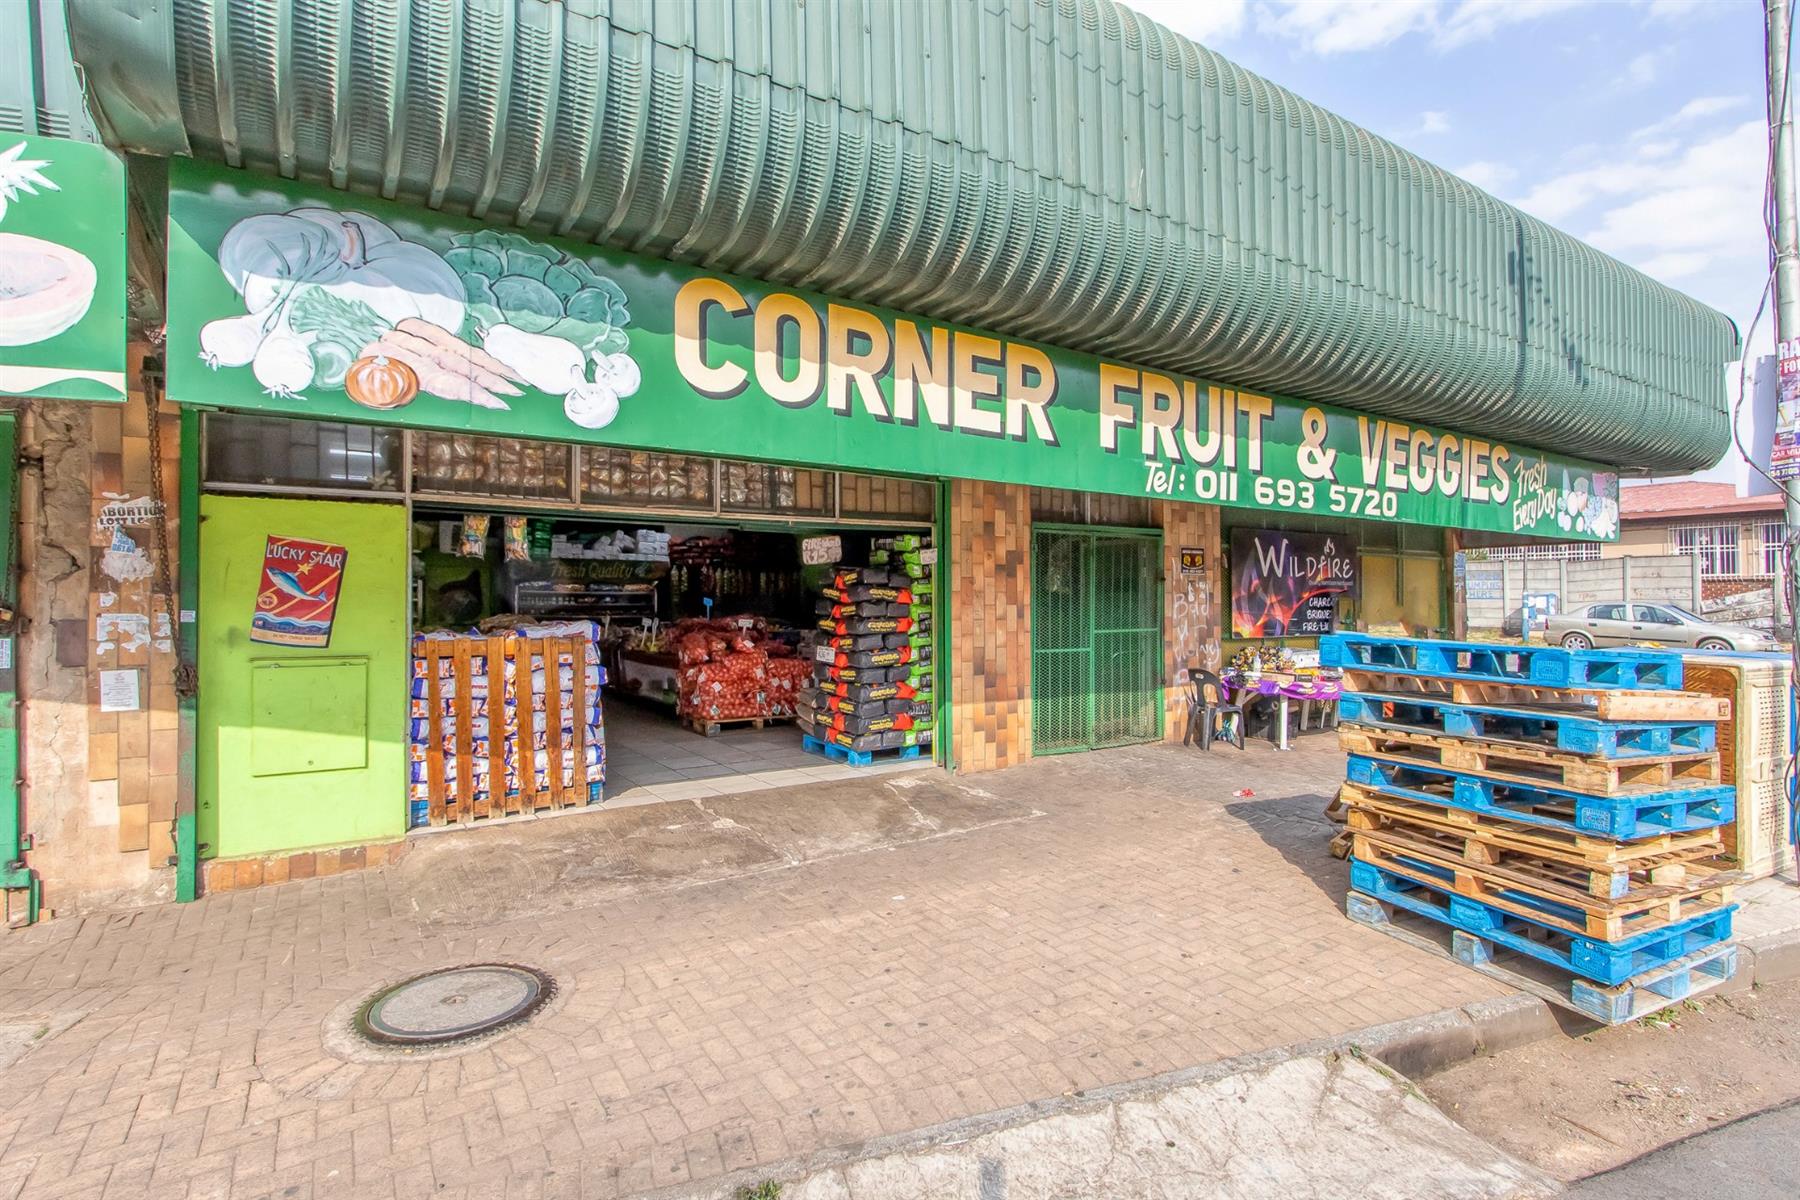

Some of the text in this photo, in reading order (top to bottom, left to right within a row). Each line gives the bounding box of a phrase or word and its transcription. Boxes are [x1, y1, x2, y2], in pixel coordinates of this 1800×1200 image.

[674, 277, 1511, 505] CORNER FRUIT & VEGGIES
[1144, 461, 1398, 517] Tel: 011 693 5720
[1513, 455, 1548, 499] Fresh
[266, 543, 342, 570] LUCKY STAR
[549, 560, 633, 580] Fresh Quality
[1254, 537, 1354, 579] WILDFIRE
